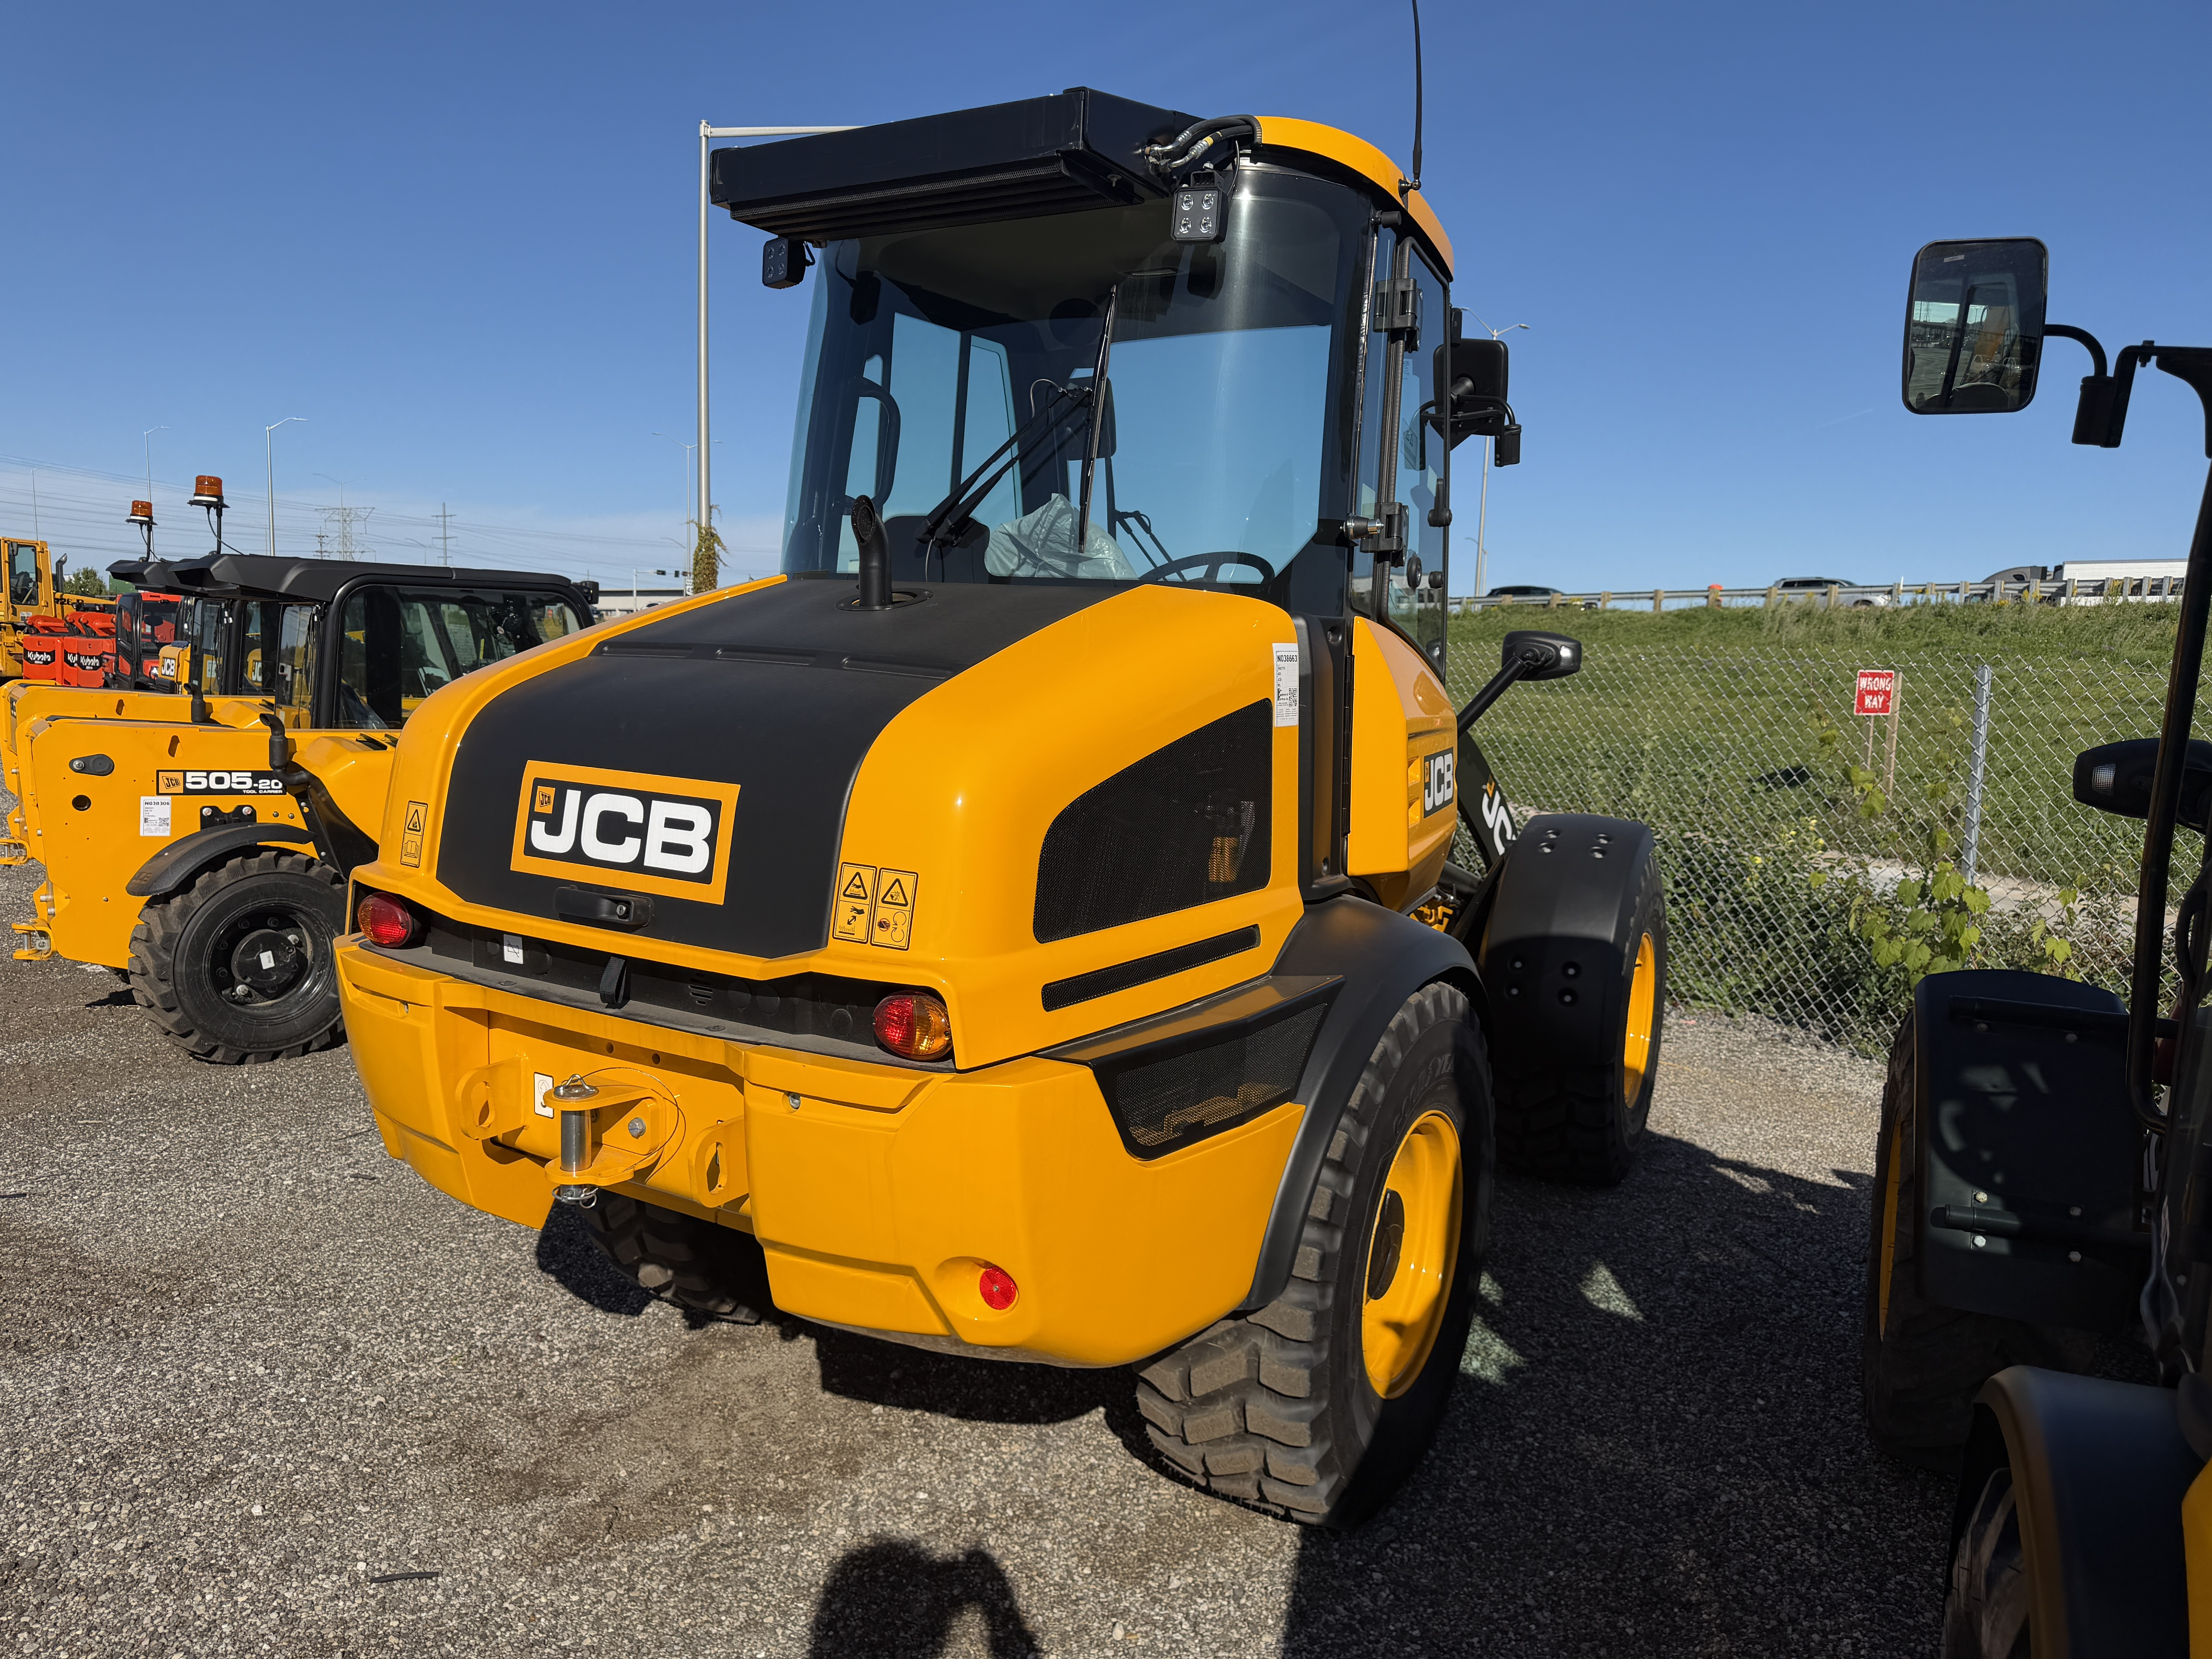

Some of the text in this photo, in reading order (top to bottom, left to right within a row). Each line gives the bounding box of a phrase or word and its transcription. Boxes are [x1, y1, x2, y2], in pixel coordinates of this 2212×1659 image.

[27, 651, 51, 661] Kubota
[80, 656, 100, 666] Kubota
[161, 658, 175, 676] JCB
[1860, 677, 1892, 691] WRONG
[1865, 695, 1884, 708] WAY
[165, 777, 179, 788] JCB
[1425, 753, 1453, 811] JCB
[540, 793, 551, 805] JCB
[1482, 790, 1516, 855] JC
[531, 789, 712, 873] JCB
